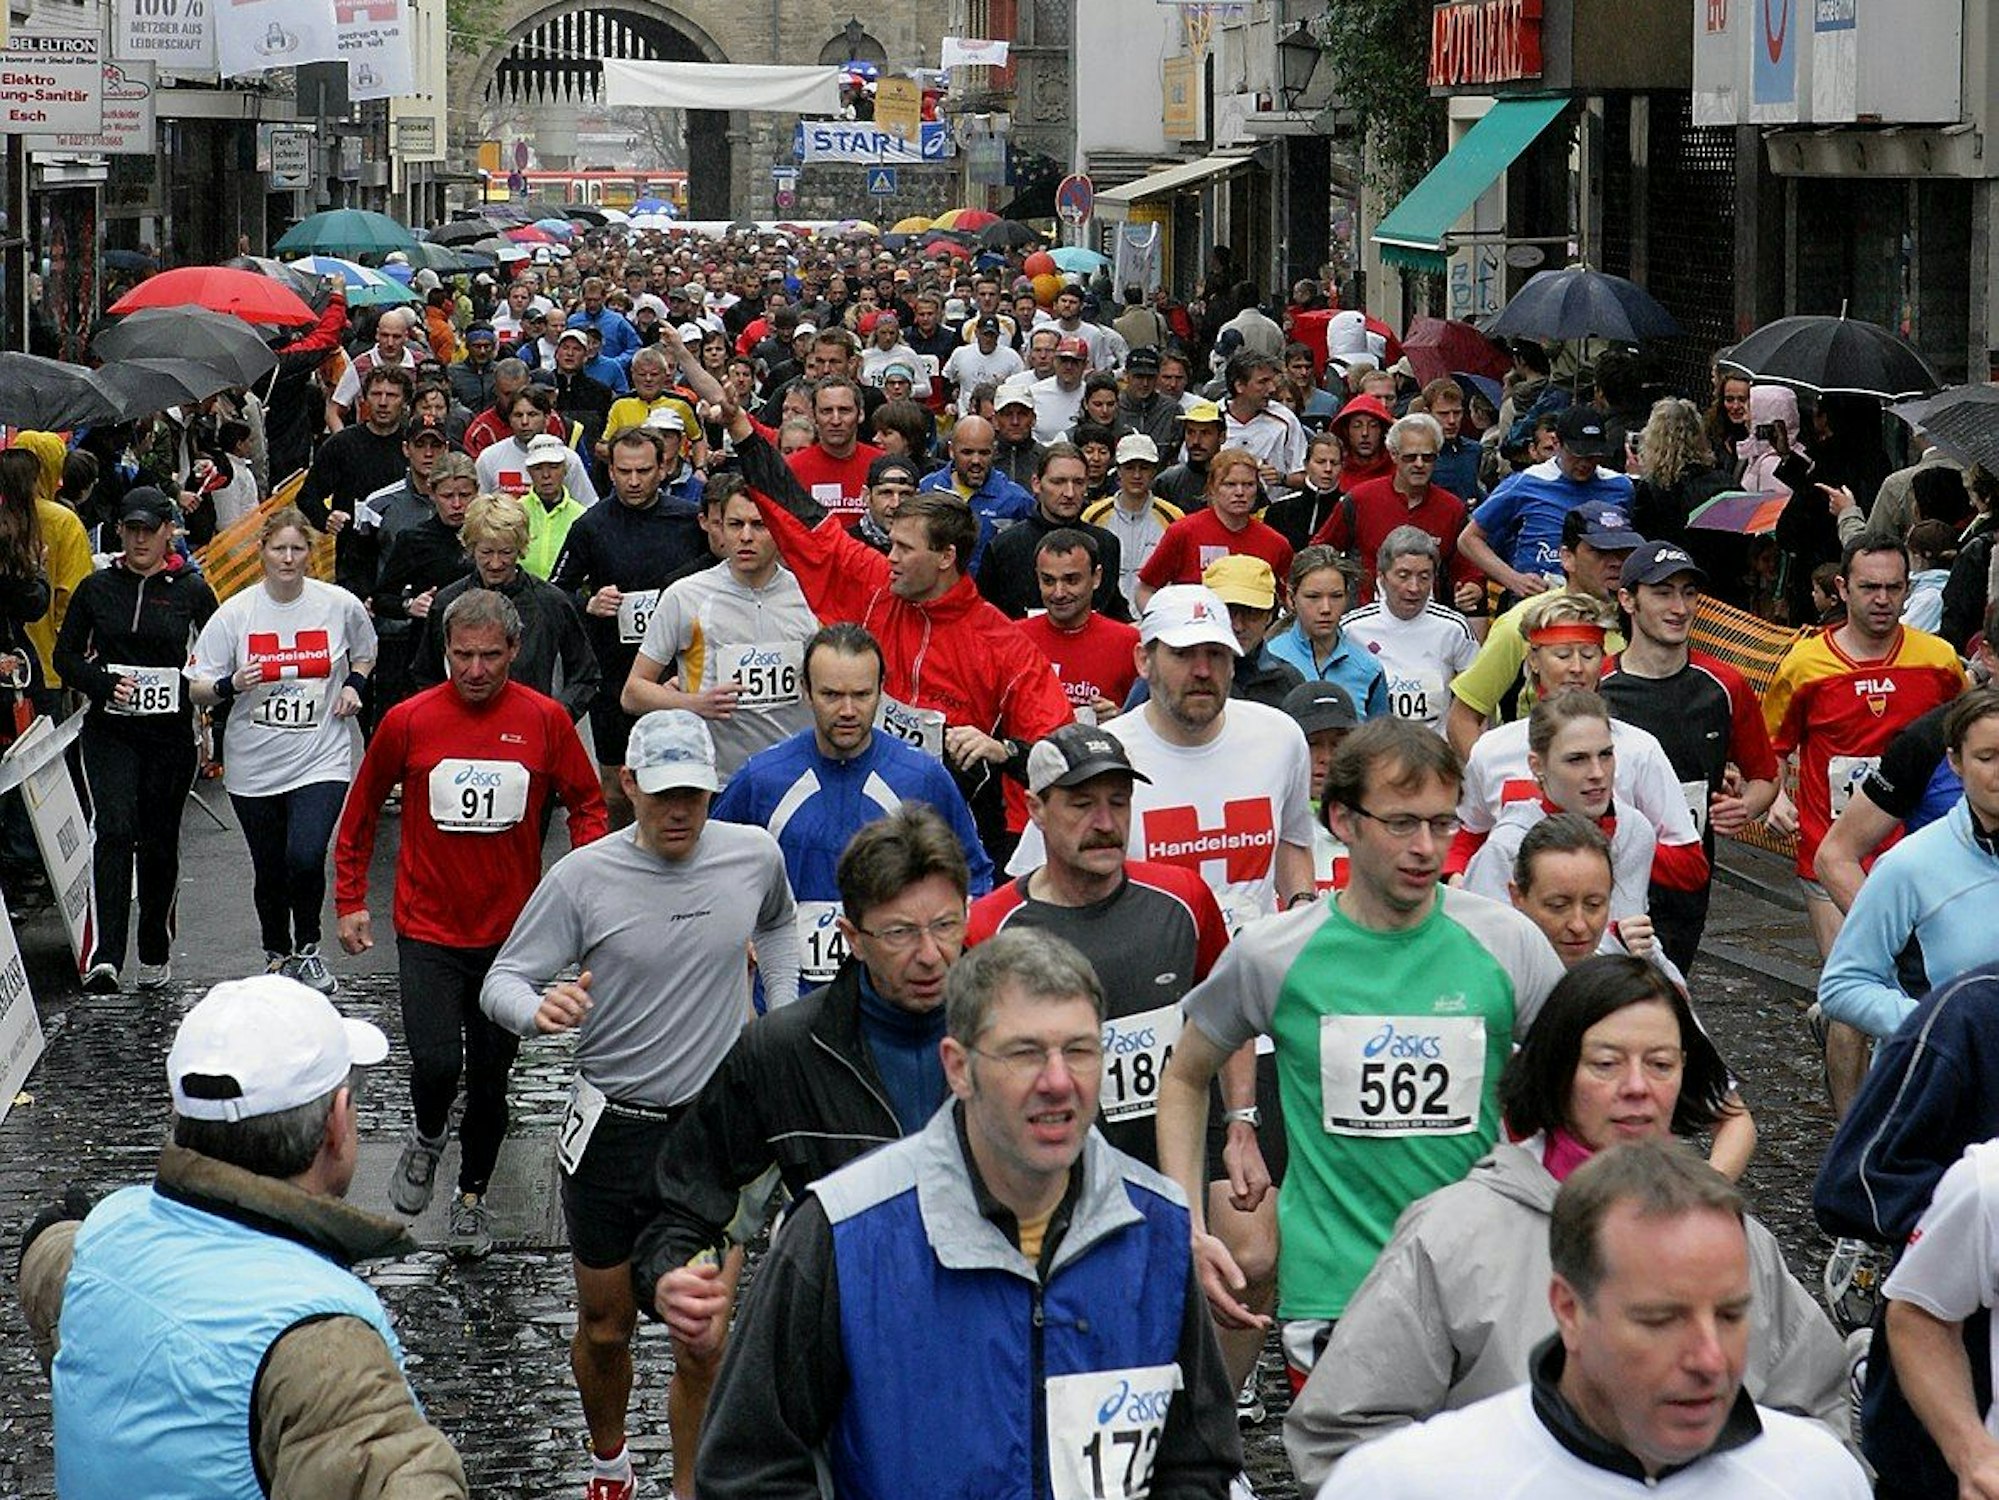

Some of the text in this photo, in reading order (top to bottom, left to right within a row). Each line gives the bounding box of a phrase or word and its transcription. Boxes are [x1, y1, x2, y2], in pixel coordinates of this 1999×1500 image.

[131, 22, 202, 35] METZGER AUS
[40, 39, 97, 52] ELTRON
[130, 38, 201, 50] LEIDENSCHAFT
[1427, 1, 1524, 87] APOTHEKE
[2, 73, 56, 86] Elektro
[0, 89, 89, 102] ung-Sanitär
[10, 109, 46, 122] Esch
[250, 649, 328, 665] Handelshof
[733, 666, 795, 697] 1516
[1397, 679, 1422, 692] asics
[1855, 678, 1896, 696] FILA
[262, 698, 315, 723] 1611
[462, 788, 495, 819] 91
[1148, 829, 1273, 859] Handelshof
[1114, 1027, 1155, 1054] asics
[1390, 1034, 1441, 1060] asics
[1360, 1063, 1450, 1117] 562
[1127, 1389, 1171, 1424] asics
